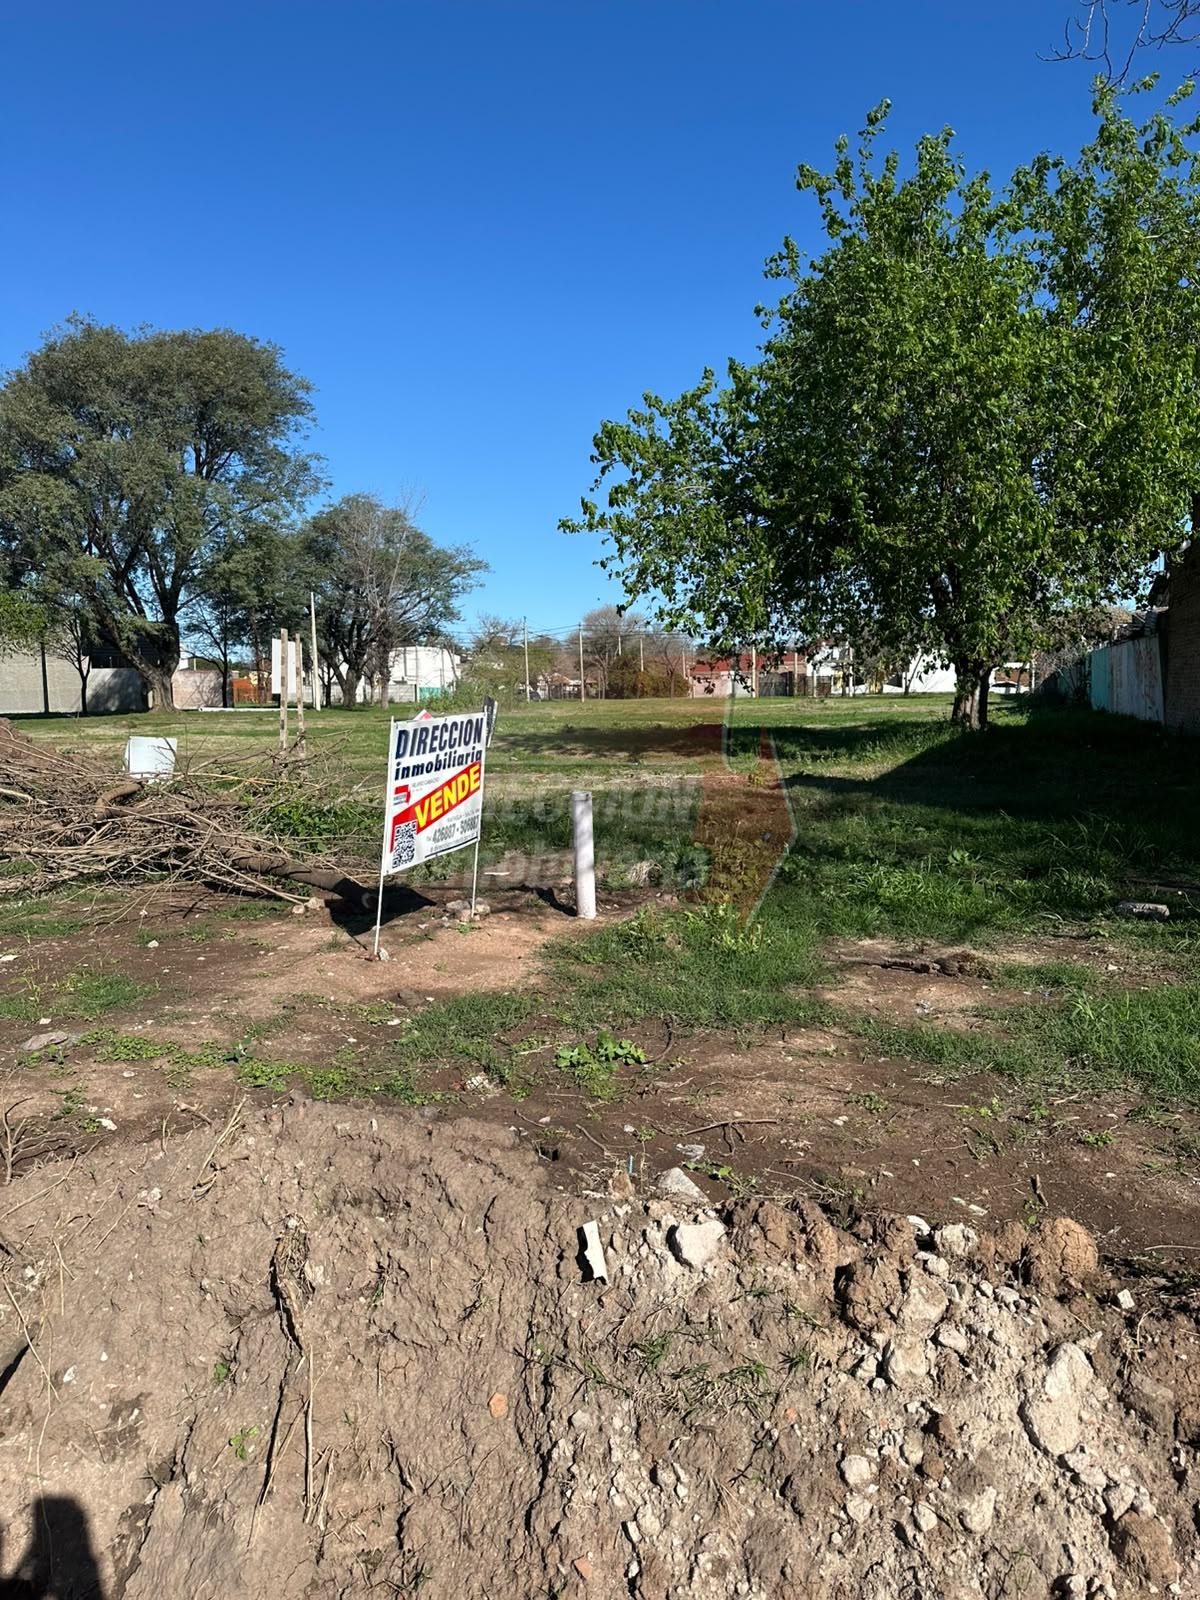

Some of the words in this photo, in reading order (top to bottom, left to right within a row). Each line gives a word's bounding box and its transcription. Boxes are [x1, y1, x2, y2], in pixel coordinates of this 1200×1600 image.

[395, 717, 484, 760] DIRECCION
[394, 746, 483, 781] inmobiliaria
[414, 763, 481, 829] VENDE
